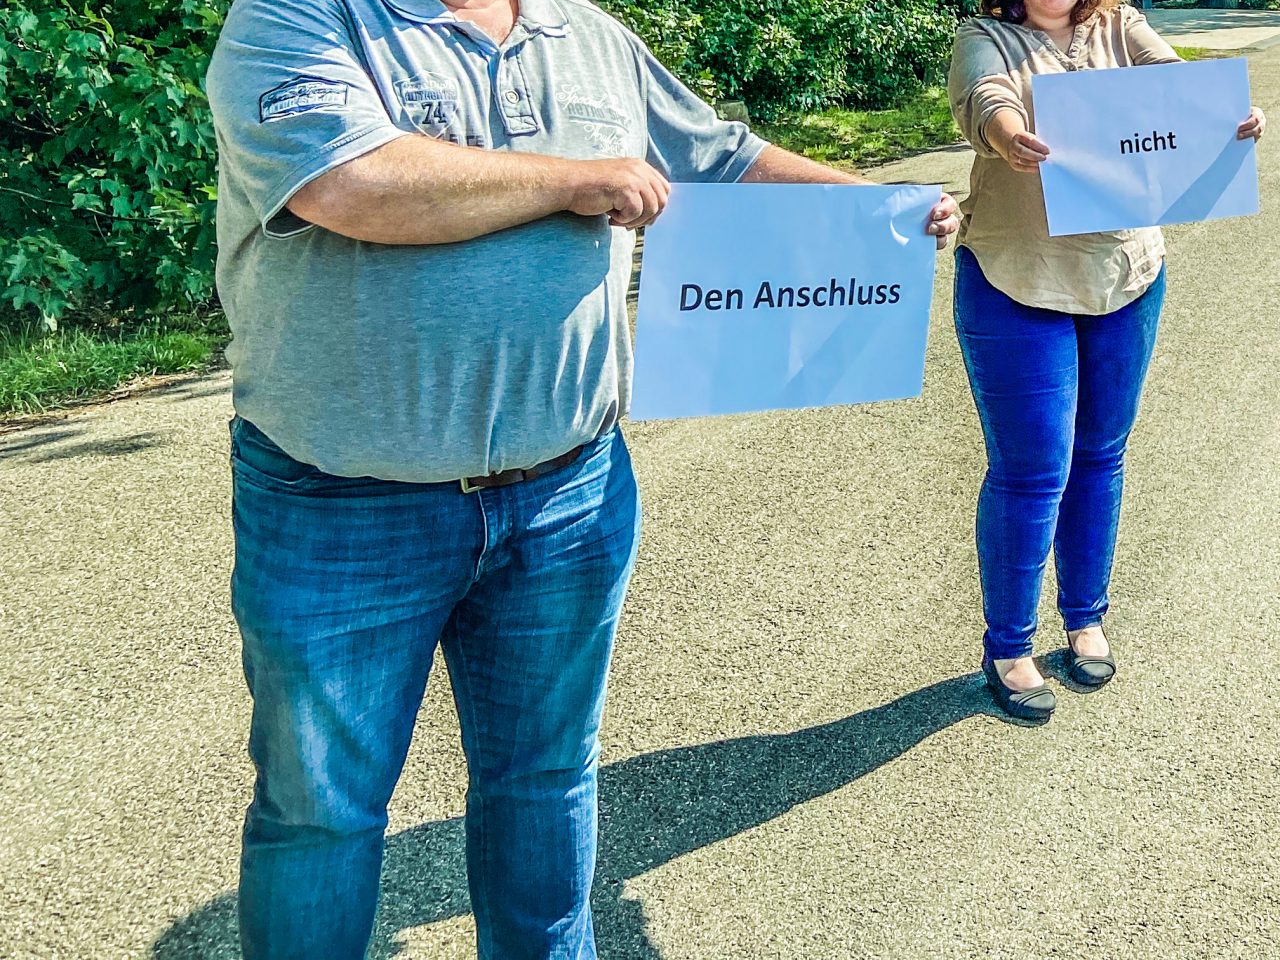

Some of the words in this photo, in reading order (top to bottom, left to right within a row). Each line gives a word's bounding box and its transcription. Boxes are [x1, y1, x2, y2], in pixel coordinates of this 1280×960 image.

[421, 101, 448, 125] 74
[1120, 130, 1177, 155] nicht
[679, 284, 744, 312] Den
[753, 278, 901, 309] Anschluss
